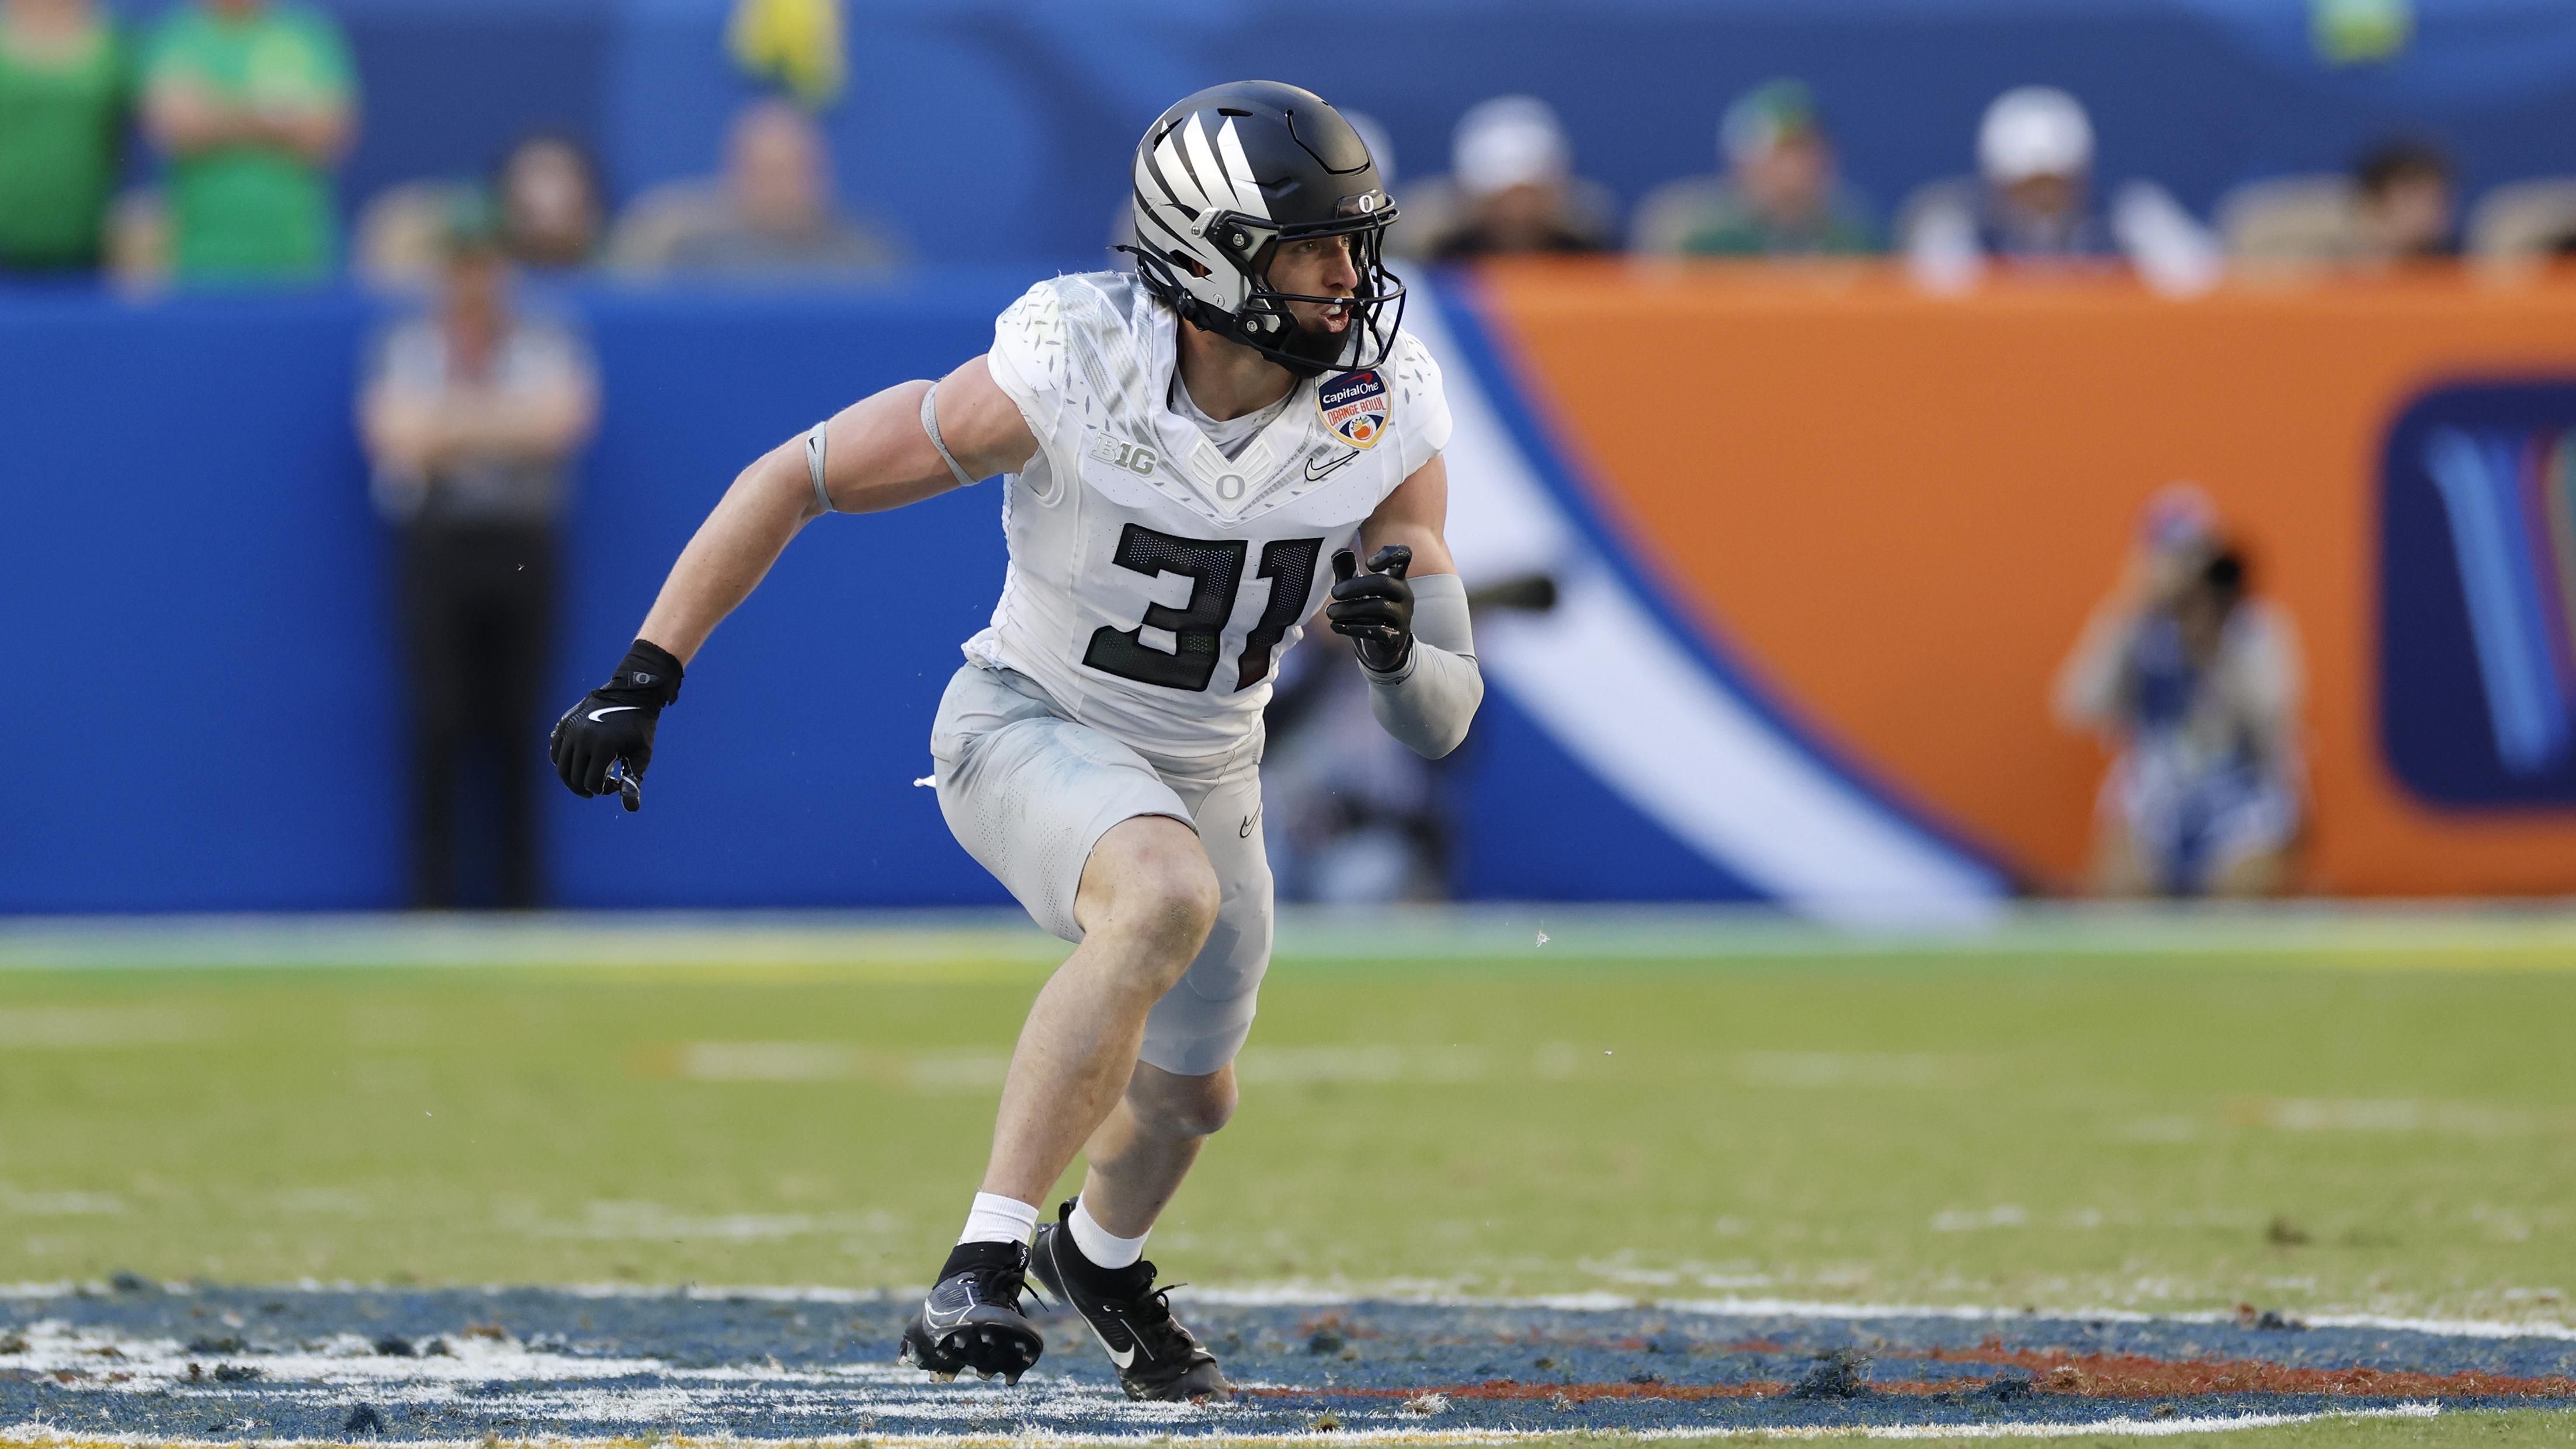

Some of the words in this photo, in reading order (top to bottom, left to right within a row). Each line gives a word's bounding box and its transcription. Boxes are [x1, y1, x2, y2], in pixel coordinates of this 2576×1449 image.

[1327, 404, 1360, 426] ORANGE
[1359, 396, 1386, 412] BOWL
[1082, 522, 1325, 693] 31
